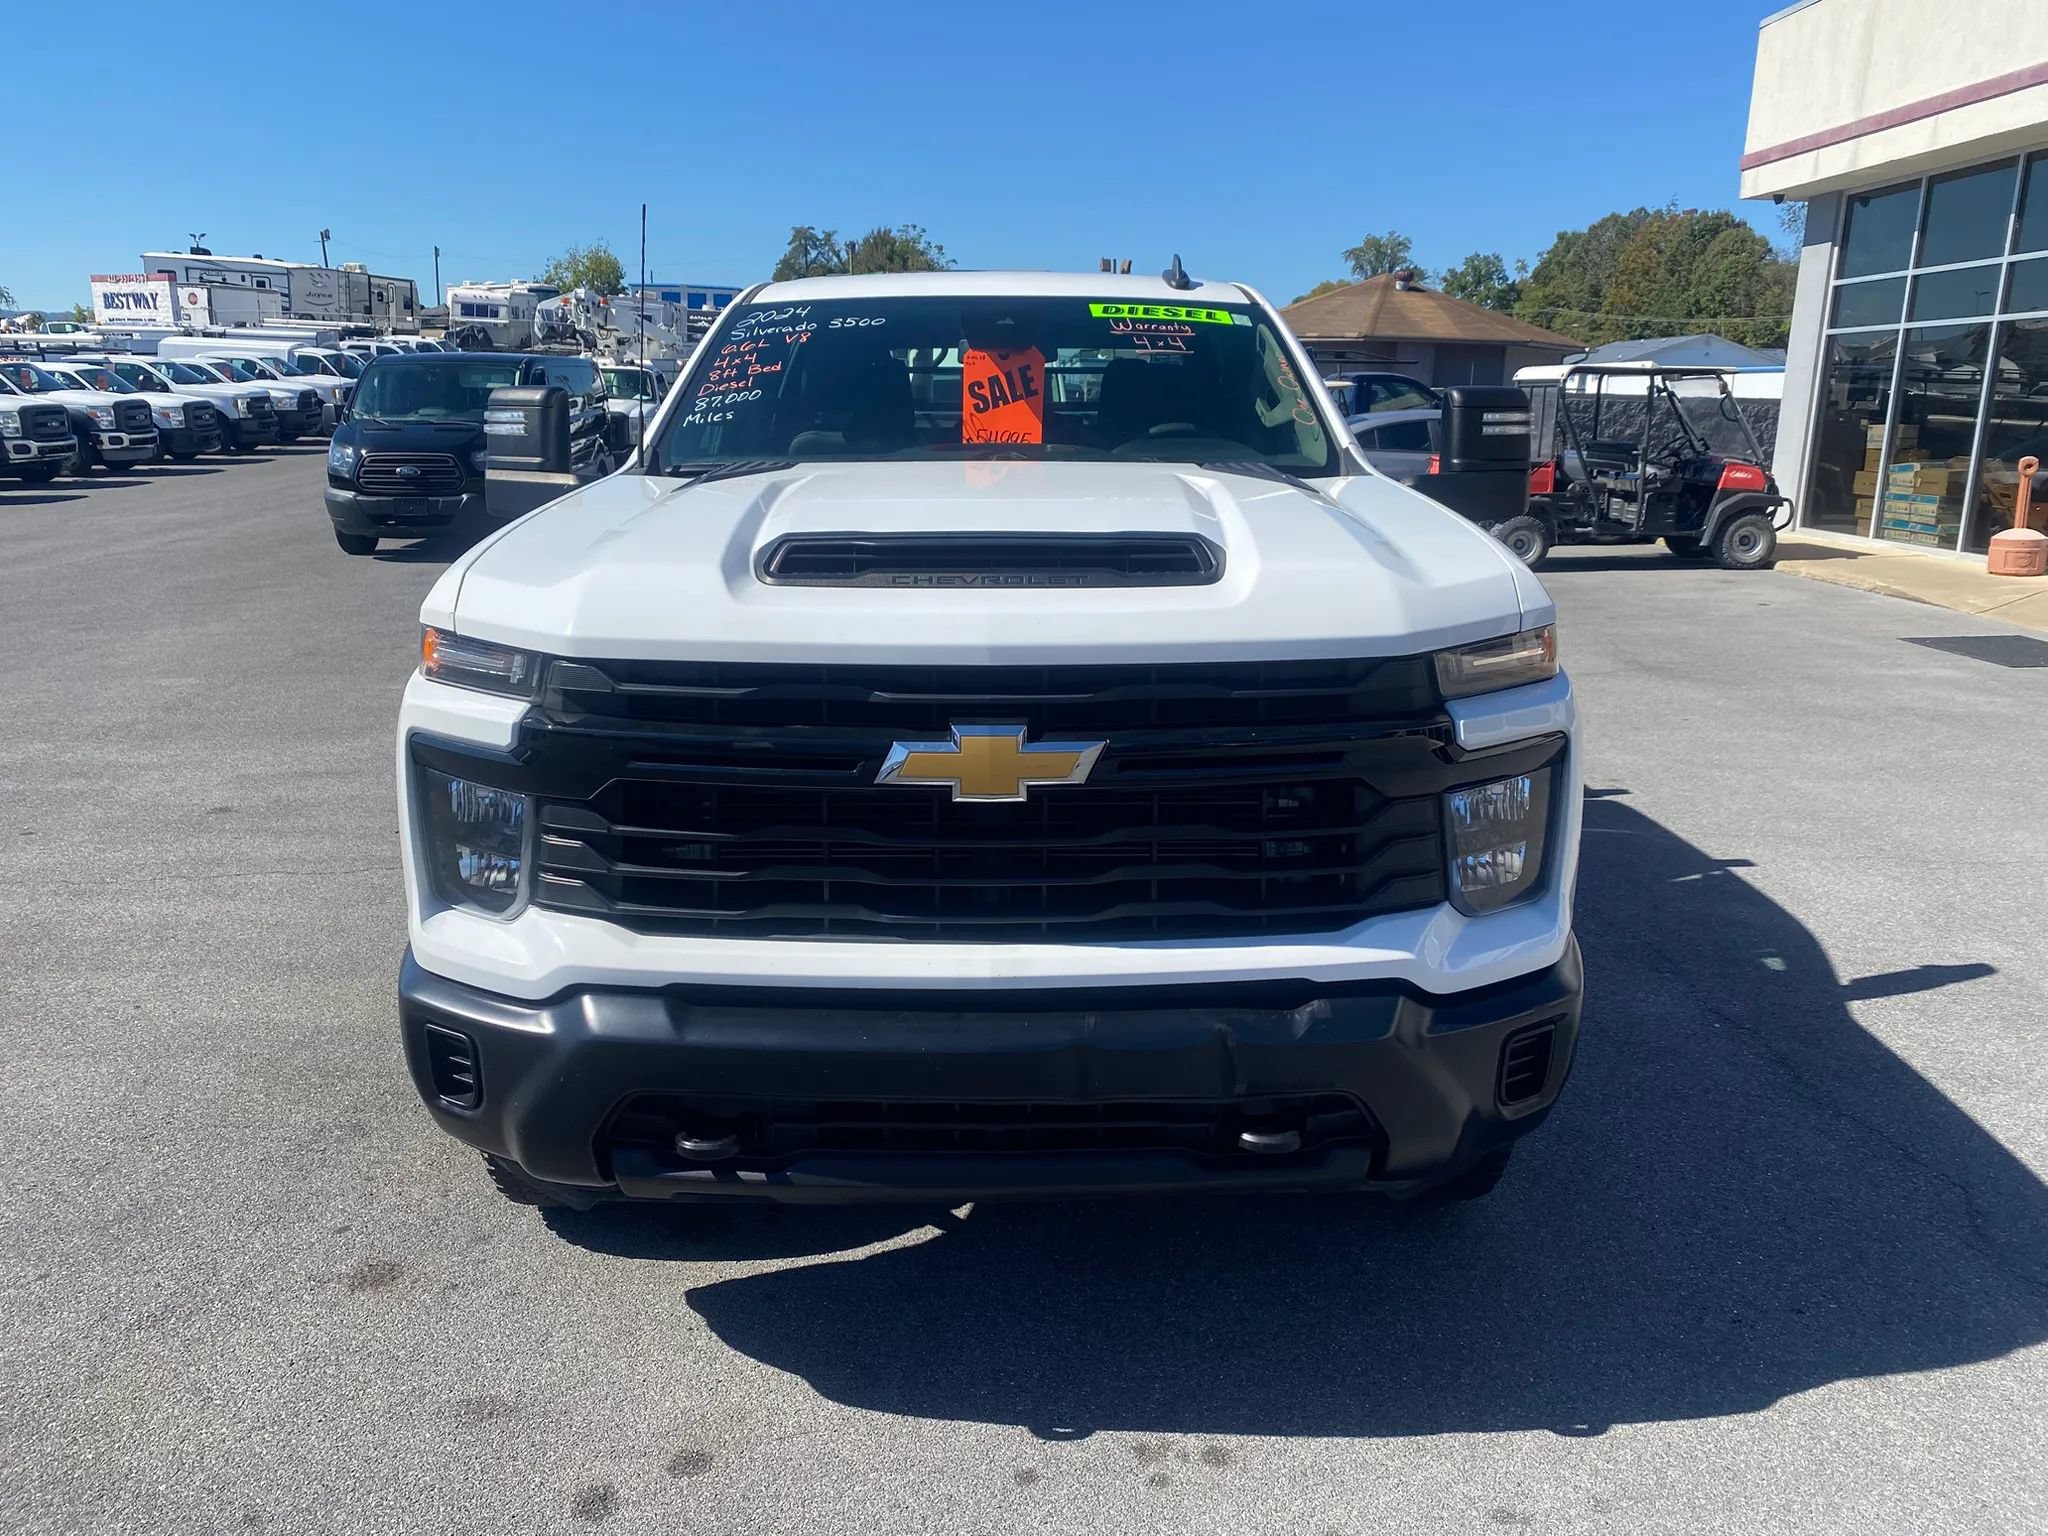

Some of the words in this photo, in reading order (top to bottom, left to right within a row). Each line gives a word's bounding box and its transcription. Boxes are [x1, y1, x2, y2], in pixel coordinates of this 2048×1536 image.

[103, 292, 159, 310] BESTWAY
[736, 305, 812, 329] 2024
[1101, 305, 1222, 322] DIESEL
[730, 321, 818, 341] Silverado
[828, 317, 886, 329] 3500
[1109, 317, 1192, 335] Warranty
[785, 331, 811, 344] V8
[708, 367, 738, 382] 8ft
[747, 360, 782, 375] Bed
[697, 376, 753, 397] Diesel
[967, 364, 1040, 414] SALE
[682, 411, 735, 428] Miles
[891, 575, 1090, 586] CHEVROLET
